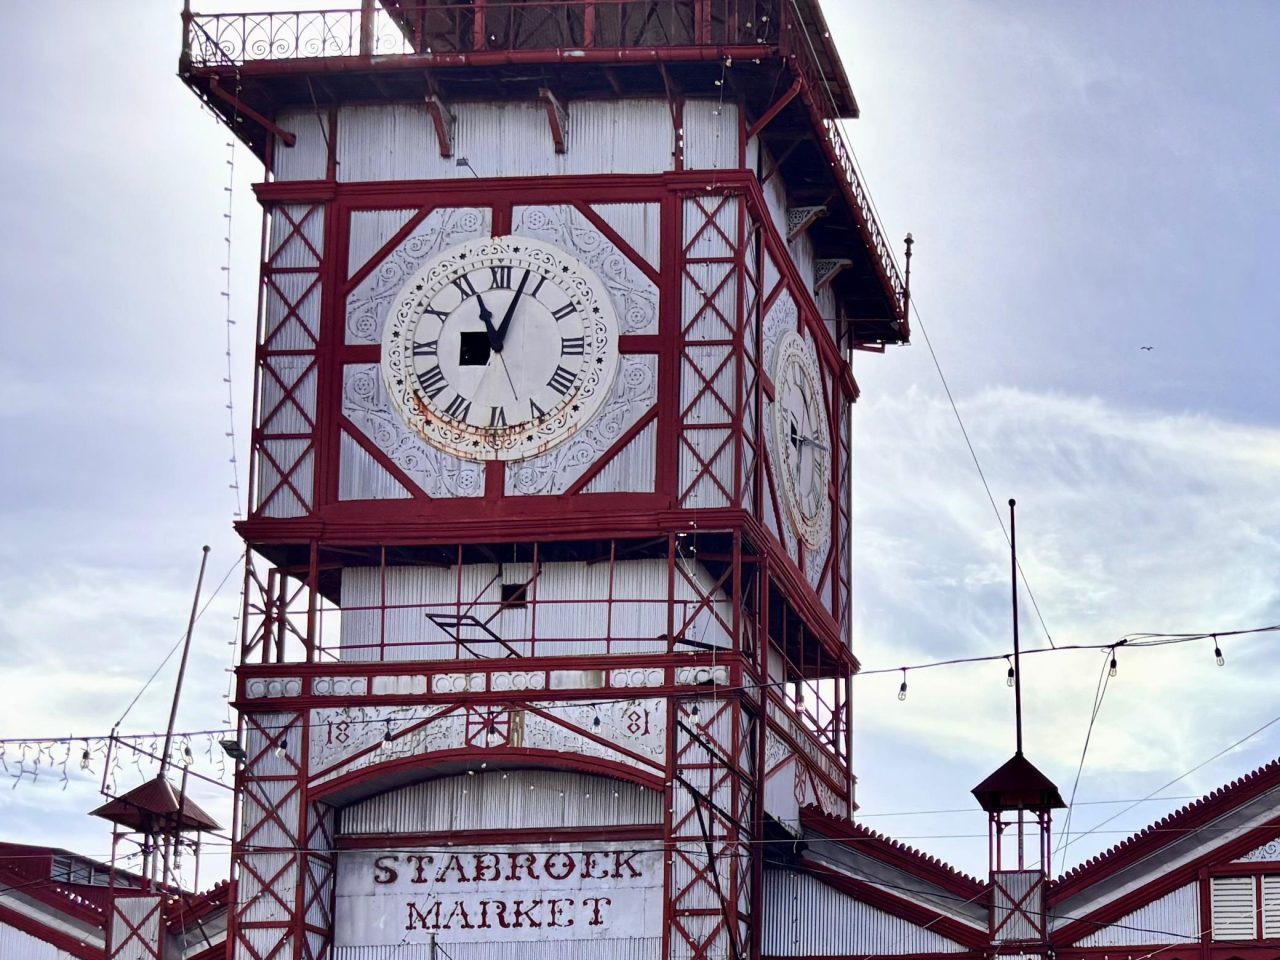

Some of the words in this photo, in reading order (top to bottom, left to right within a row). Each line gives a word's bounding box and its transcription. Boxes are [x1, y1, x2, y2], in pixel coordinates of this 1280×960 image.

[452, 274, 477, 302] XI
[490, 266, 513, 289] XII
[424, 303, 451, 323] X
[551, 300, 578, 321] II
[413, 340, 438, 356] IX
[561, 336, 584, 357] III
[546, 364, 577, 396] IIII
[442, 393, 472, 422] VII
[325, 720, 350, 745] 18
[627, 708, 650, 736] 81
[374, 850, 642, 884] STABROEK
[405, 897, 612, 931] MARKET
